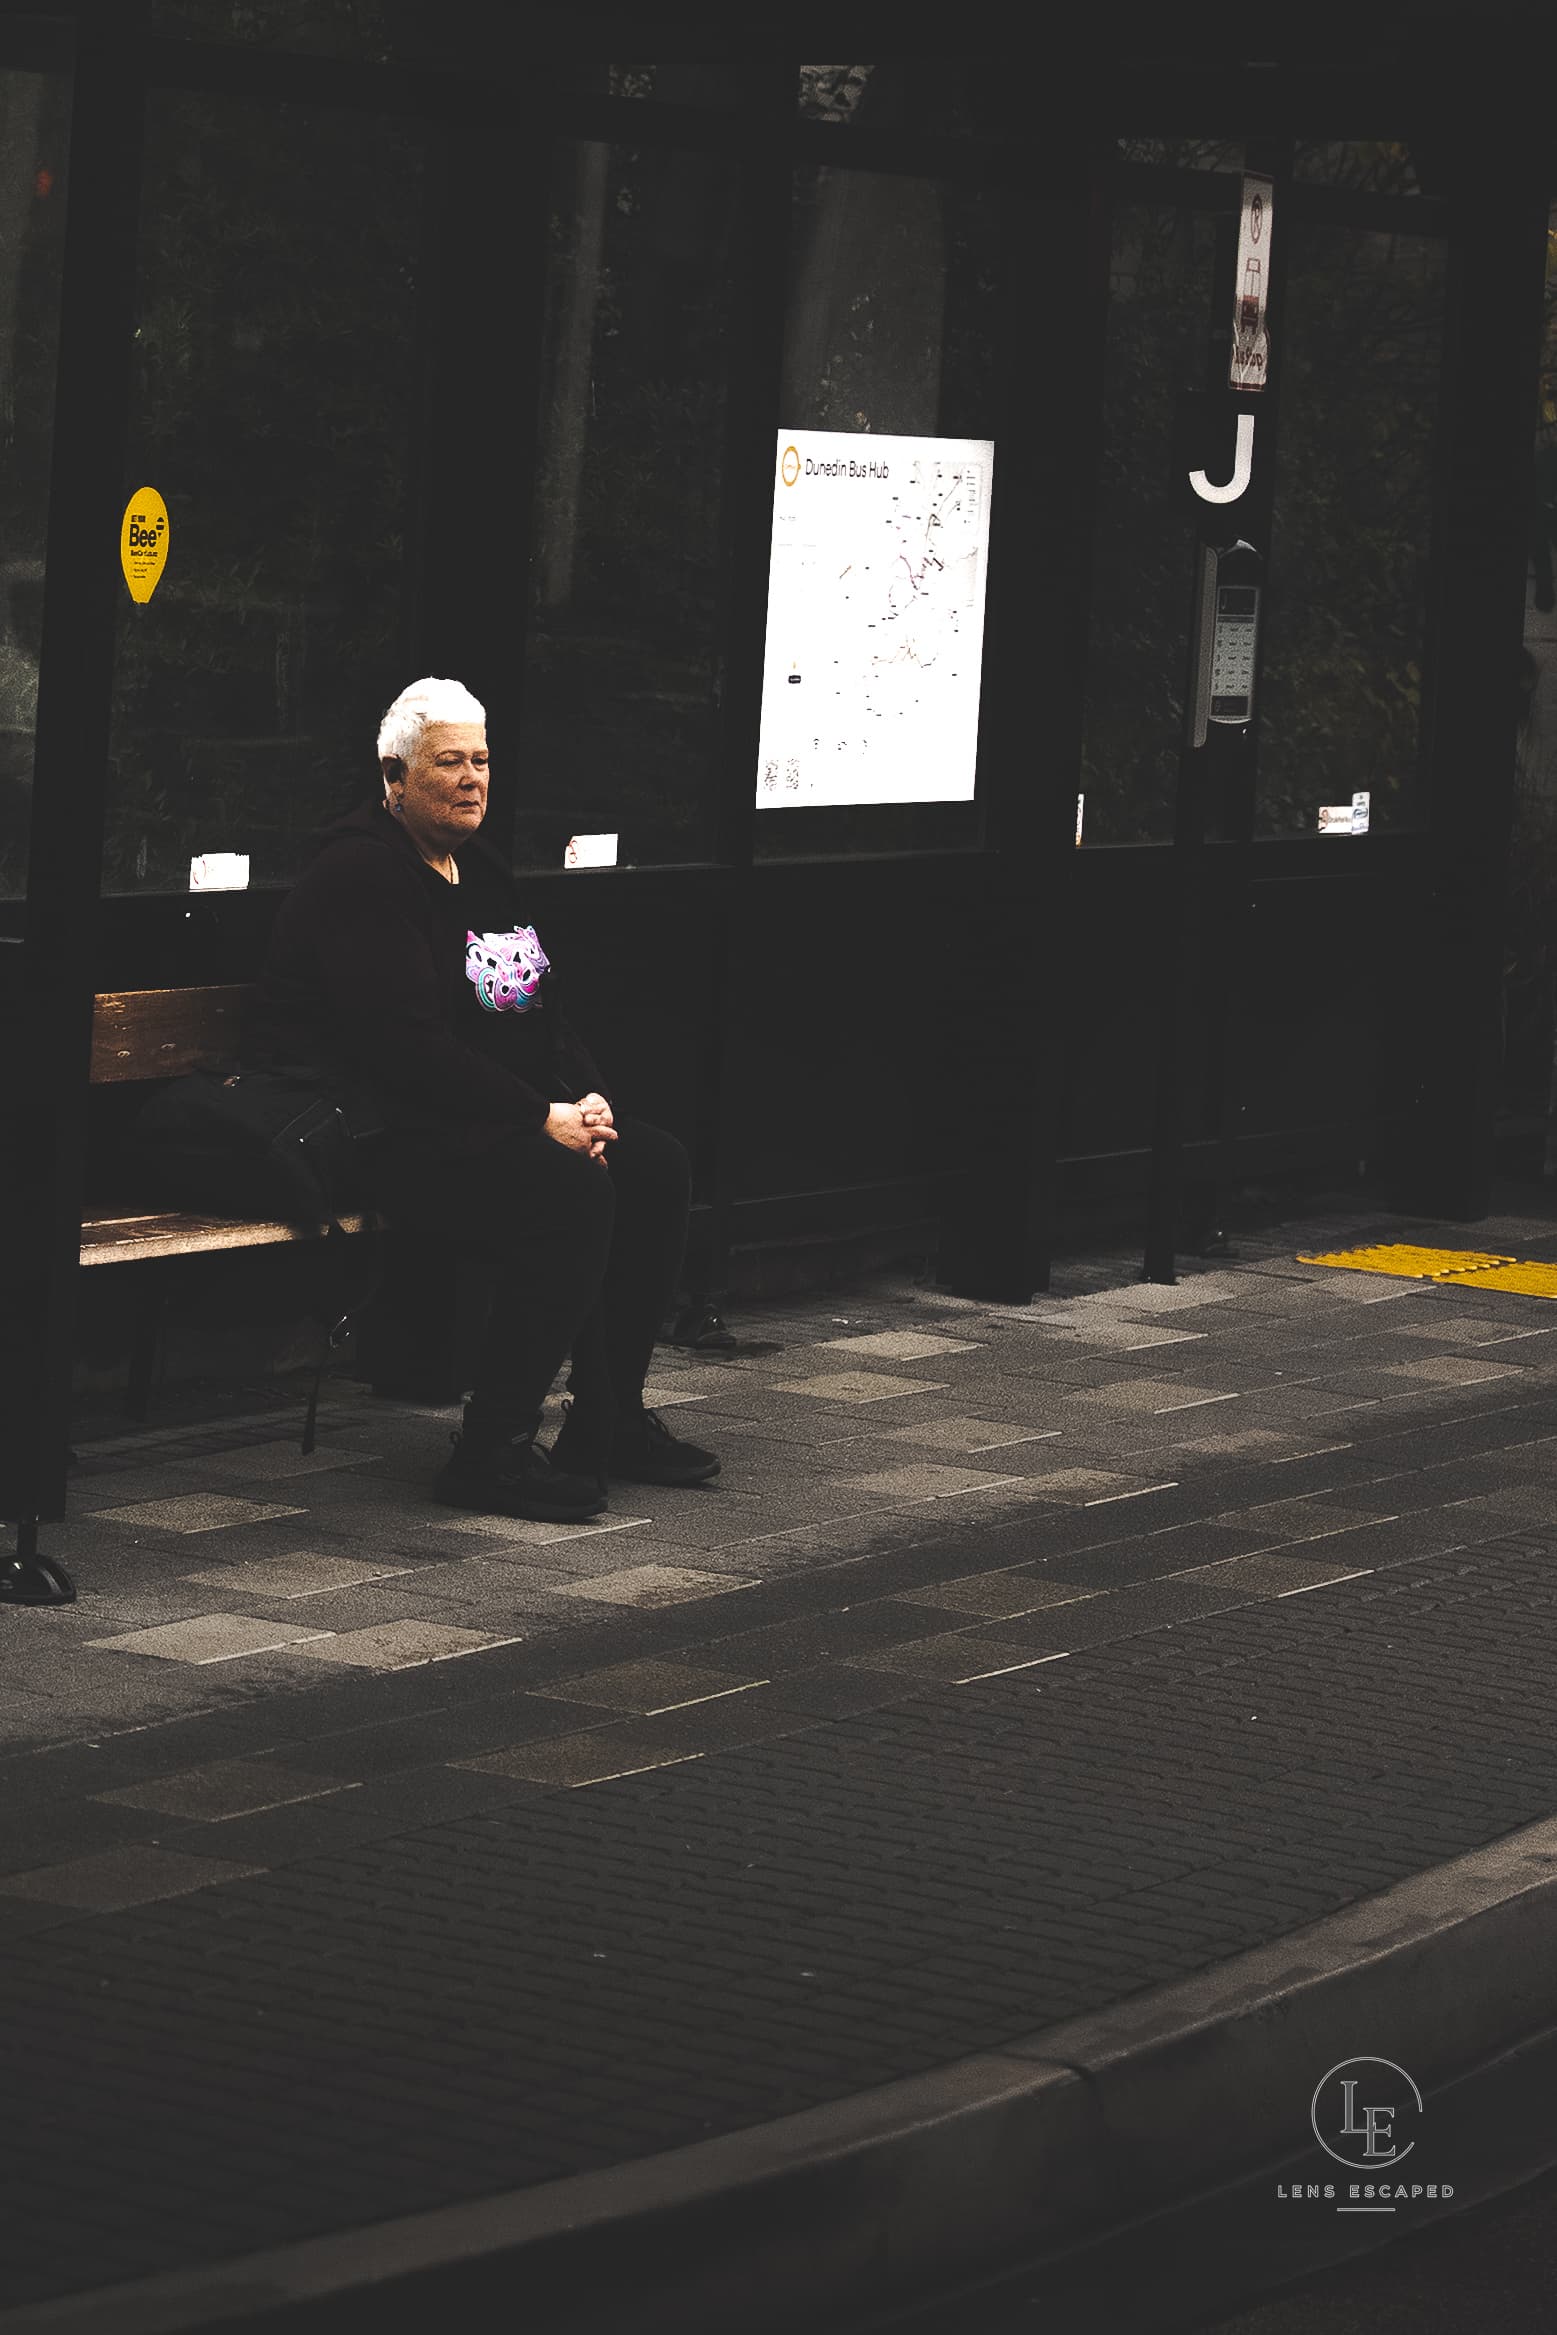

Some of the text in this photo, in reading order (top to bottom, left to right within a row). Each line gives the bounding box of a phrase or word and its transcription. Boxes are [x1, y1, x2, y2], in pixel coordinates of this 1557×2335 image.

[805, 458, 889, 479] Dunedin Bus Hub
[1189, 414, 1254, 503] J
[129, 524, 157, 547] Bee
